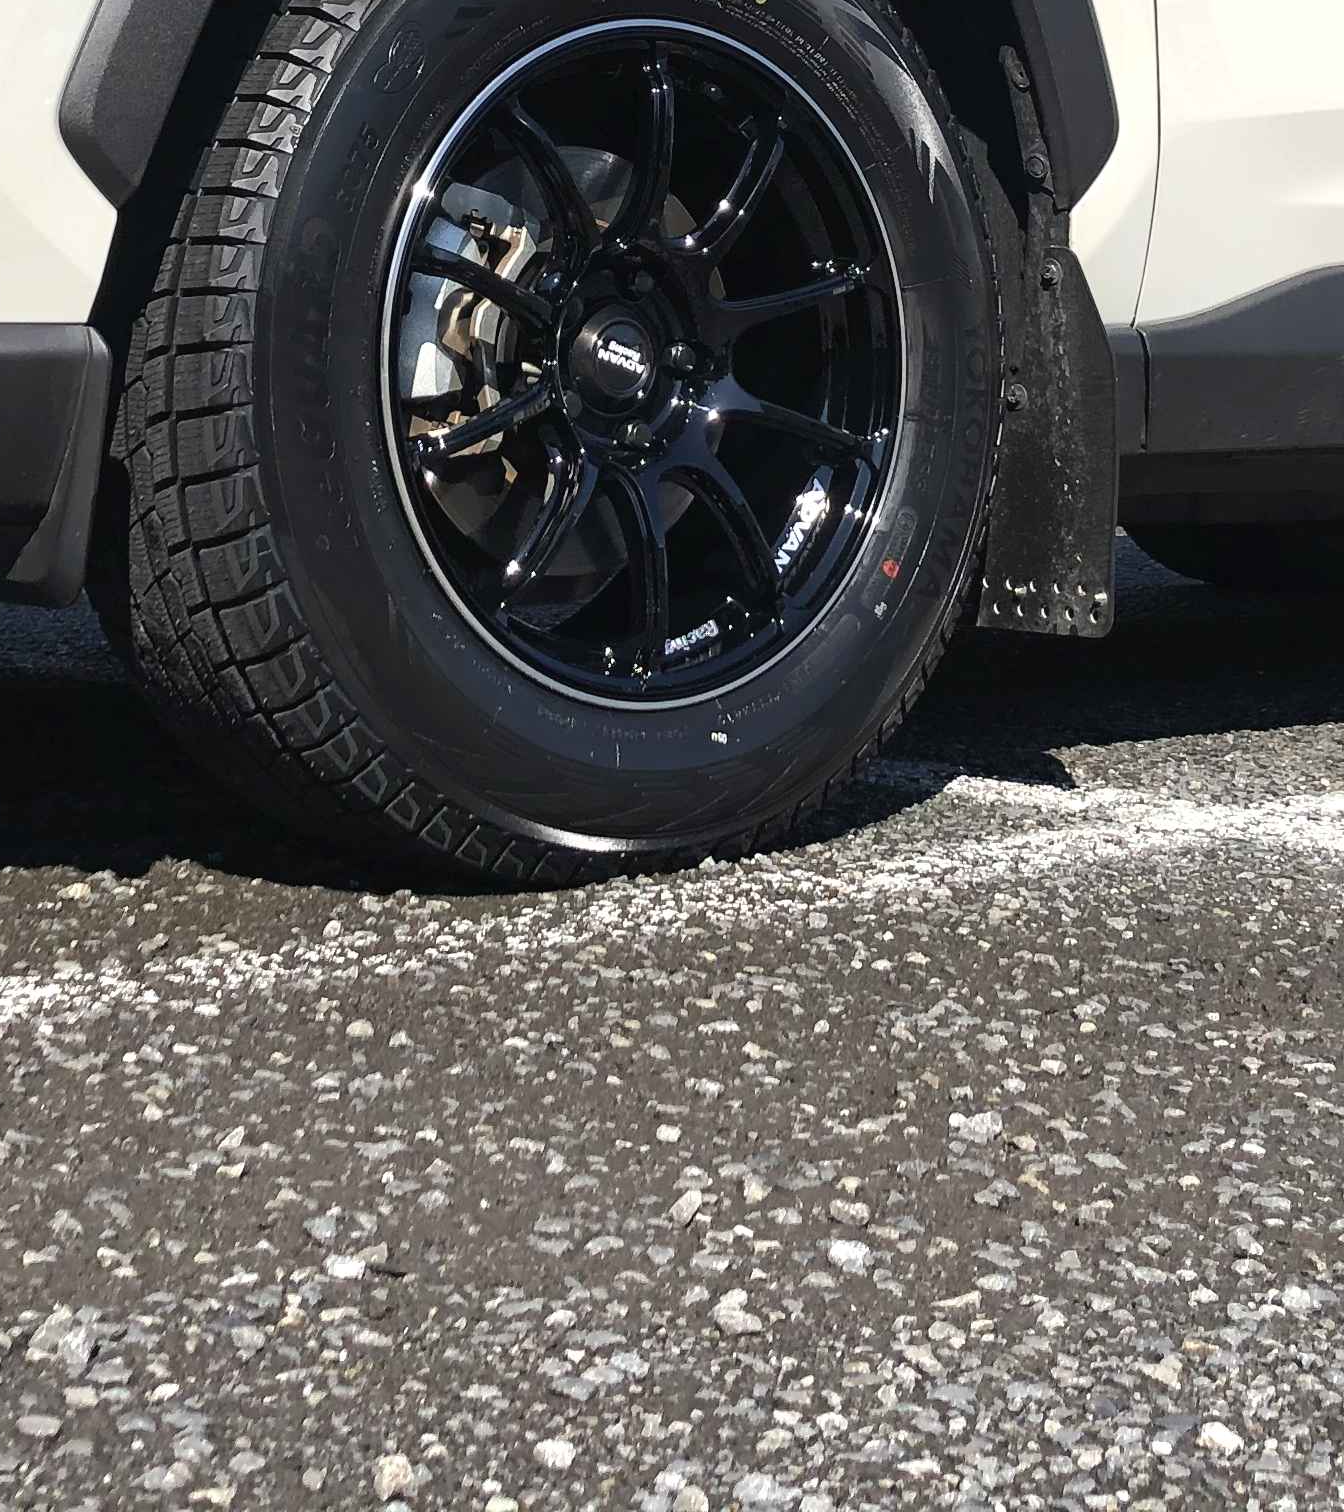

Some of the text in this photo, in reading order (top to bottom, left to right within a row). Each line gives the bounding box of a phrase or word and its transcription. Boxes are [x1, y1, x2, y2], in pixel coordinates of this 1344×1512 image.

[597, 348, 645, 374] ADVAN
[774, 478, 829, 575] ADVAN
[665, 619, 720, 656] Racing
